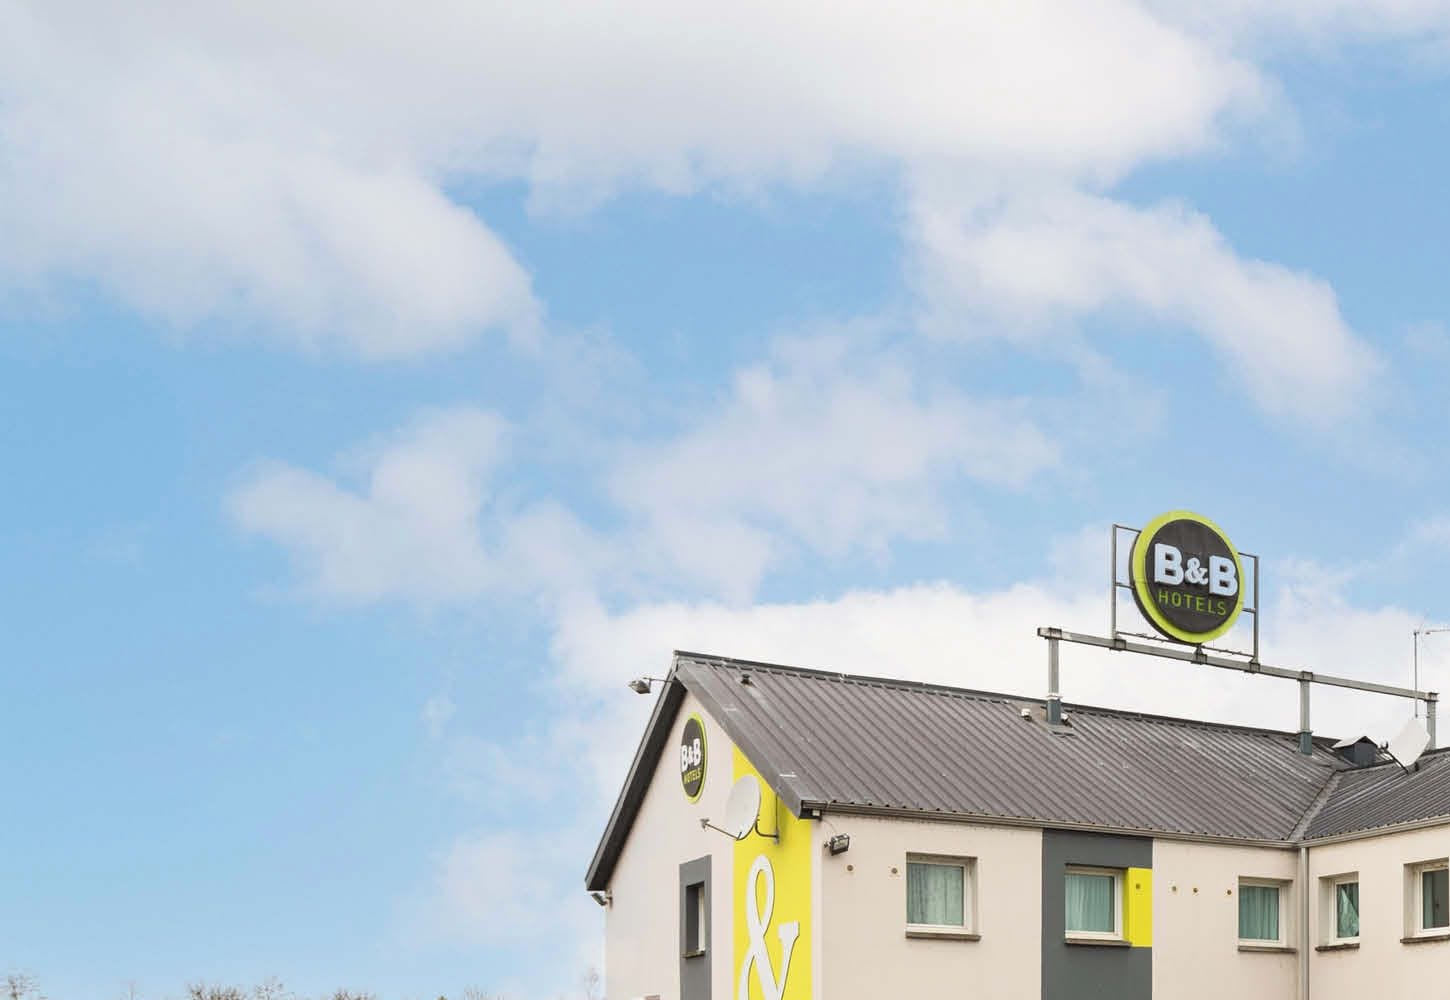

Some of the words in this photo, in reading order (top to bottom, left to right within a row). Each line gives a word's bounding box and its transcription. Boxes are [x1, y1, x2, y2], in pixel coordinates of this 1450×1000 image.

[1154, 543, 1238, 597] B&B
[1158, 589, 1226, 616] HOTELS
[681, 738, 701, 772] B&B
